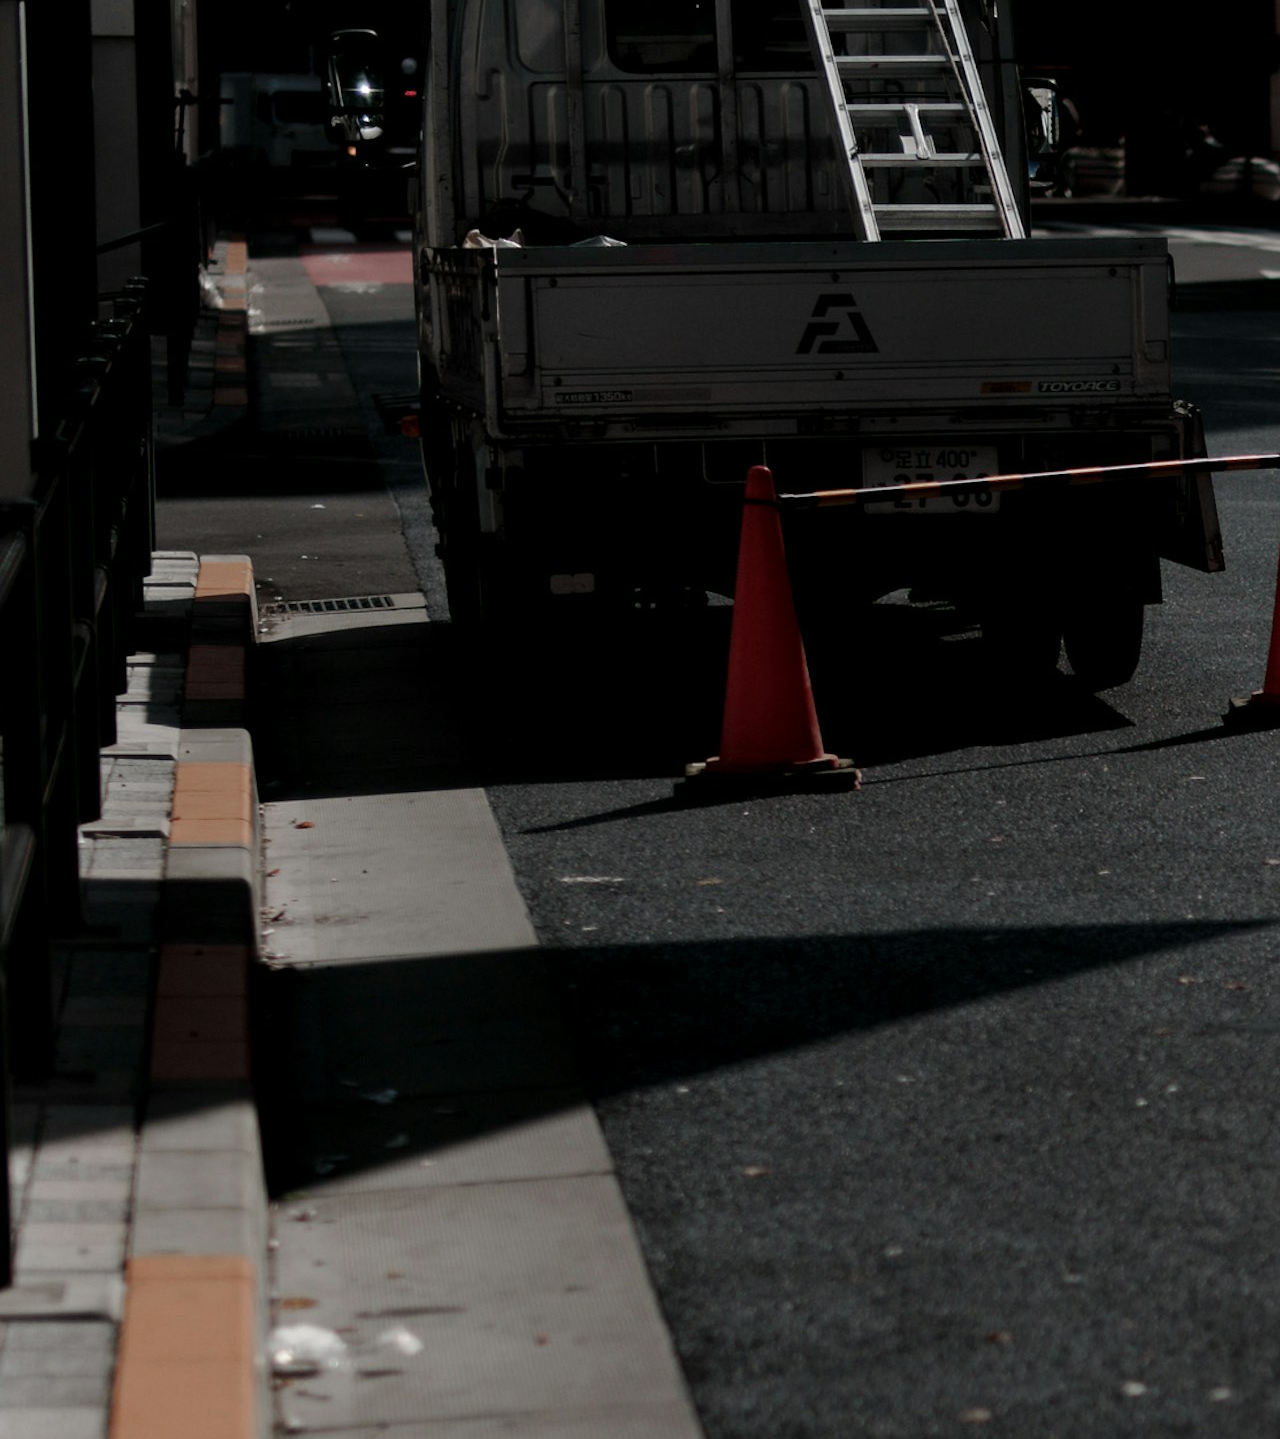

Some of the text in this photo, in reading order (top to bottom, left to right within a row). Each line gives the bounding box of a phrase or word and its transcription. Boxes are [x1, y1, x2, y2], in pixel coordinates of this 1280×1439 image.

[1040, 380, 1120, 393] TOYOACE
[895, 449, 970, 469] 足立 400
